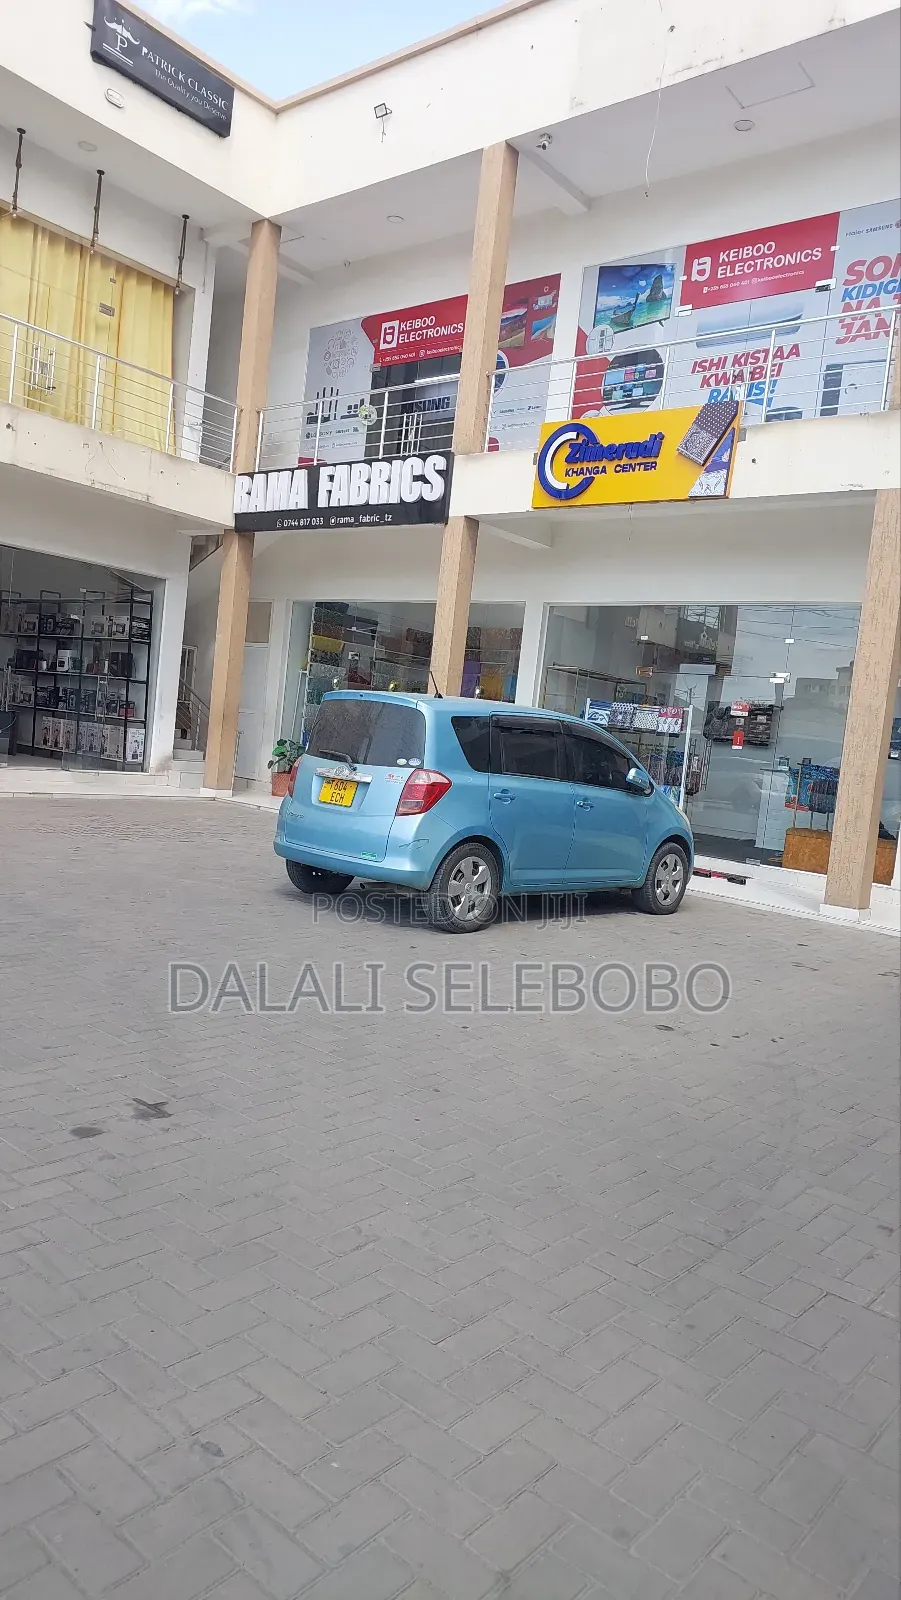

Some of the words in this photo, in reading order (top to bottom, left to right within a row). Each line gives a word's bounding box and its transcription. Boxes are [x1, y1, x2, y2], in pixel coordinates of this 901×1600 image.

[141, 46, 185, 83] PATRICK
[188, 78, 229, 111] CLASSIC
[717, 247, 822, 278] ELECTRONICS
[719, 241, 776, 263] KEIBOO
[398, 322, 464, 344] ELECTRONICS
[400, 315, 436, 331] KEIBOO
[691, 355, 729, 374] ISHI
[731, 343, 801, 368] KISTAA
[700, 368, 745, 389] KWA
[750, 362, 784, 381] BEI
[564, 464, 607, 478] KHANGA
[614, 460, 658, 474] CENTER
[233, 468, 309, 514] RAMA
[317, 454, 447, 508] FABRICS
[283, 518, 299, 527] 0744
[299, 517, 310, 527] 817
[311, 517, 324, 526] 033
[329, 791, 345, 804] ECH
